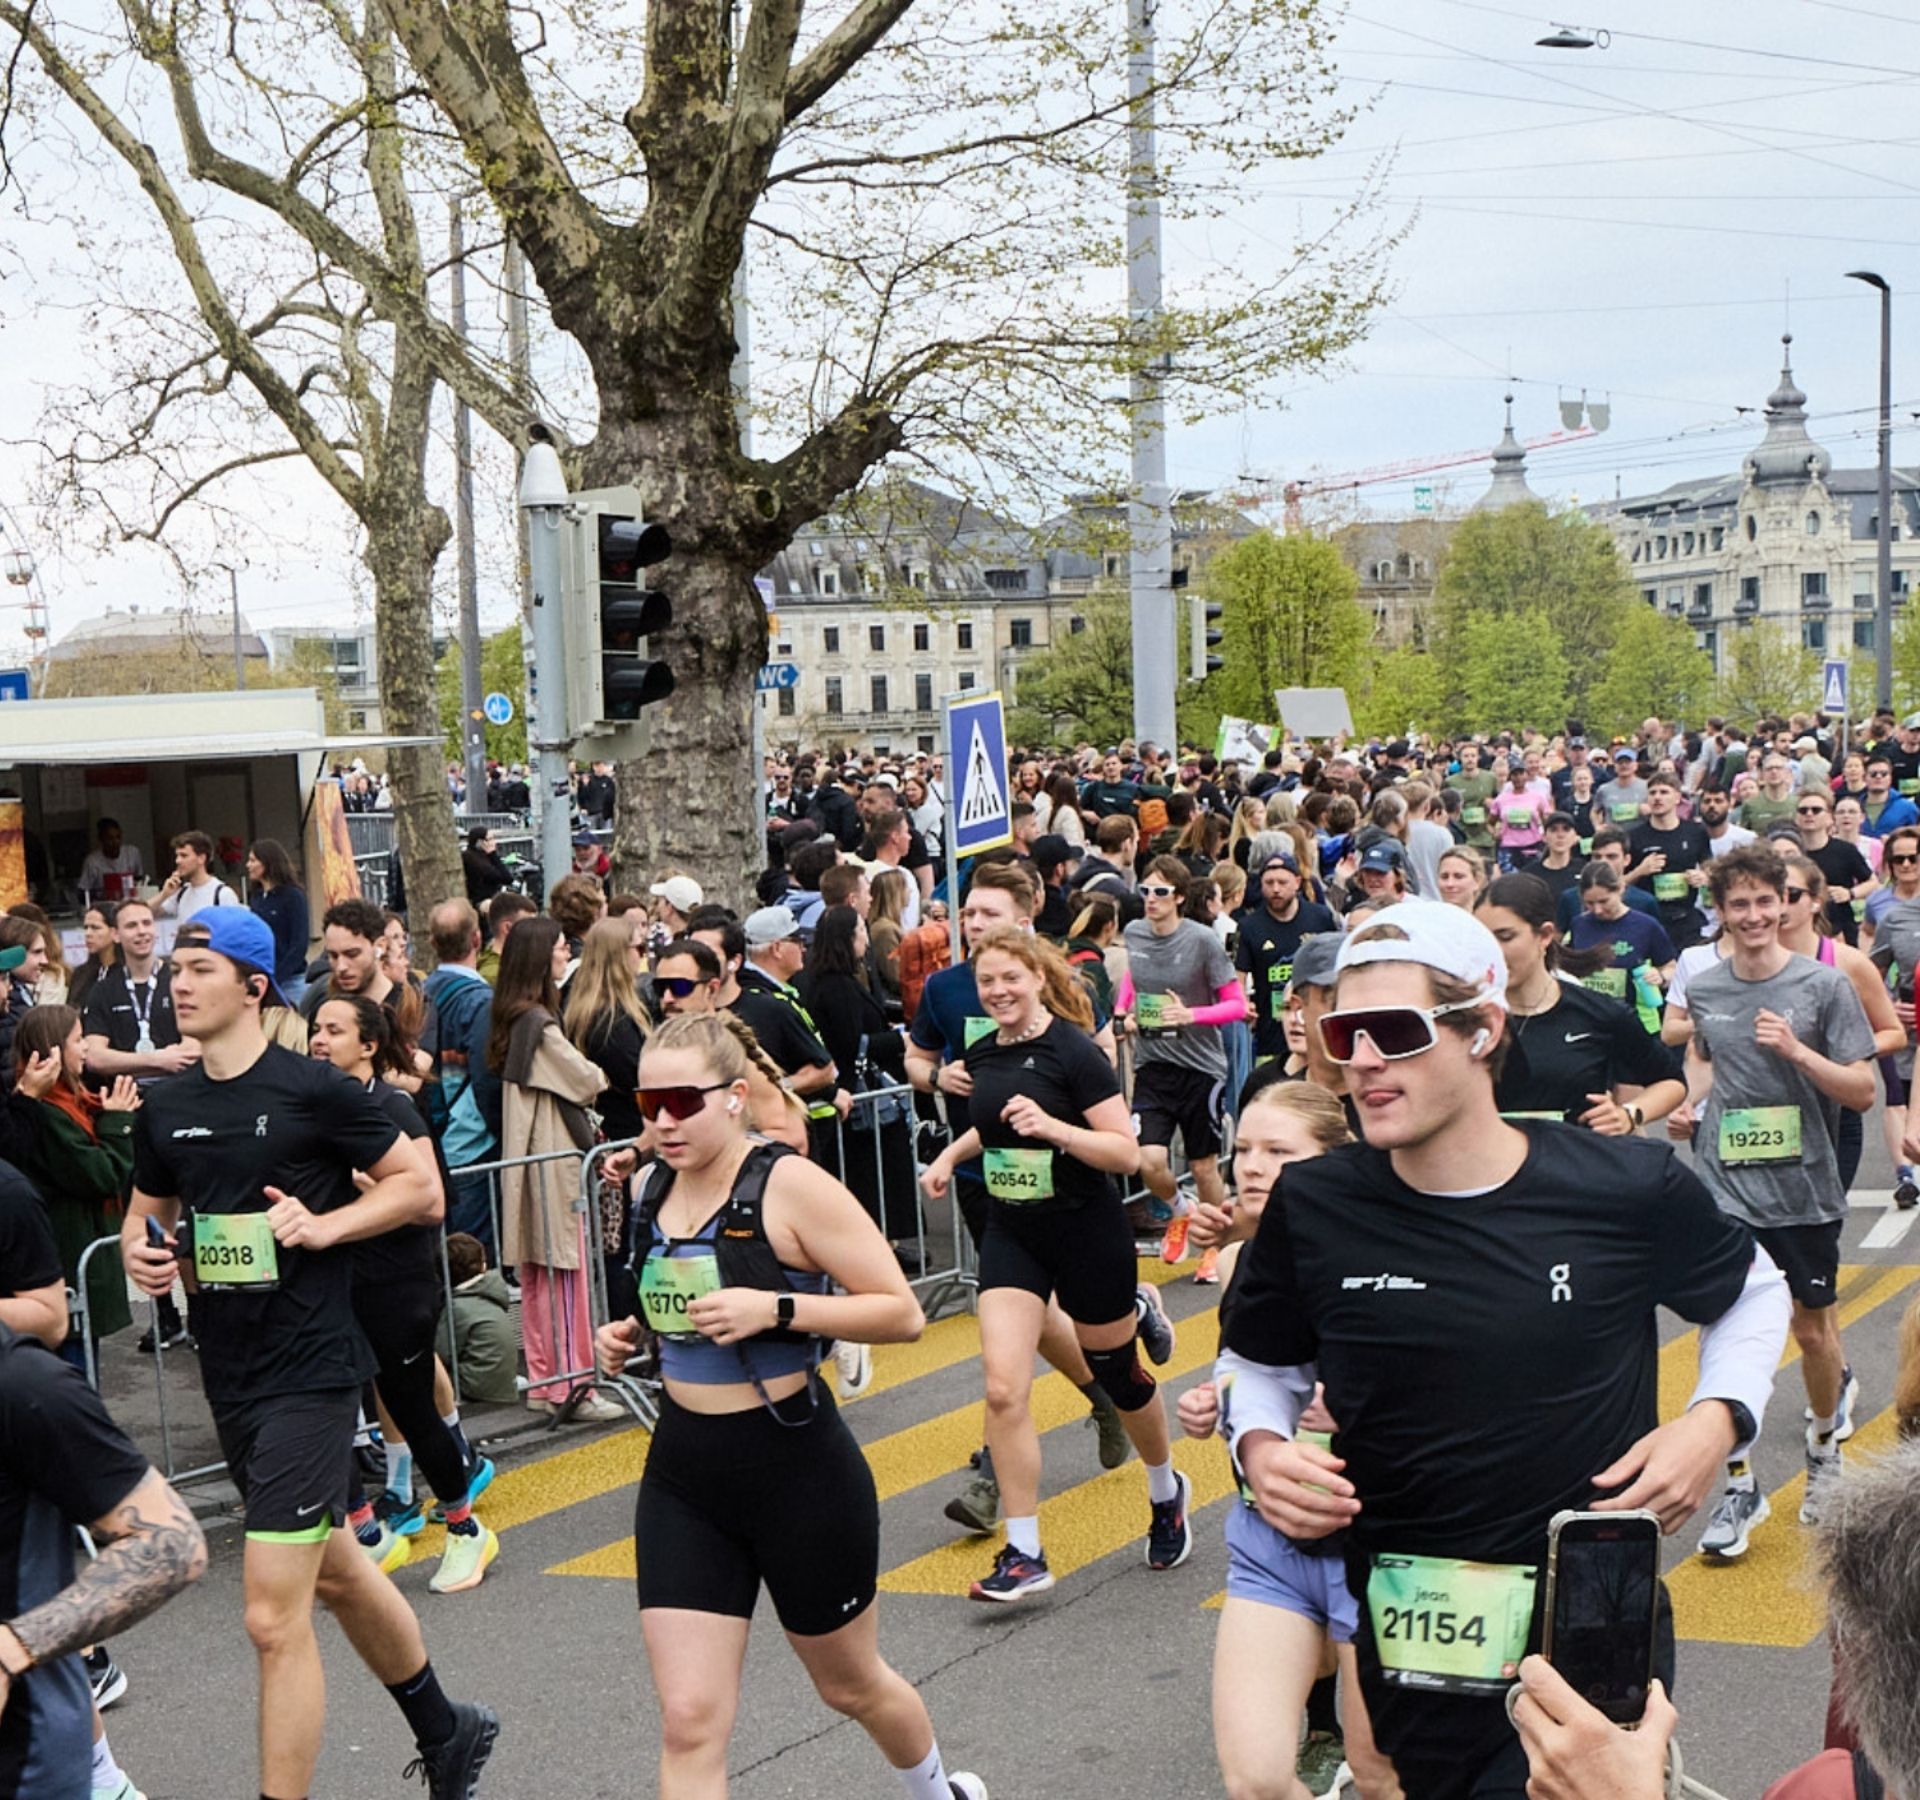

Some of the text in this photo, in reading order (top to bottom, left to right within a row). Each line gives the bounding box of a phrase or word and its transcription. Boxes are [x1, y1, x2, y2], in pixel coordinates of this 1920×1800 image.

[759, 666, 788, 686] WC
[1727, 1131, 1785, 1147] 19223
[990, 1171, 1037, 1187] 20542
[200, 1245, 254, 1265] 20318
[1414, 1586, 1450, 1602] jean
[1383, 1606, 1487, 1648] 21154
